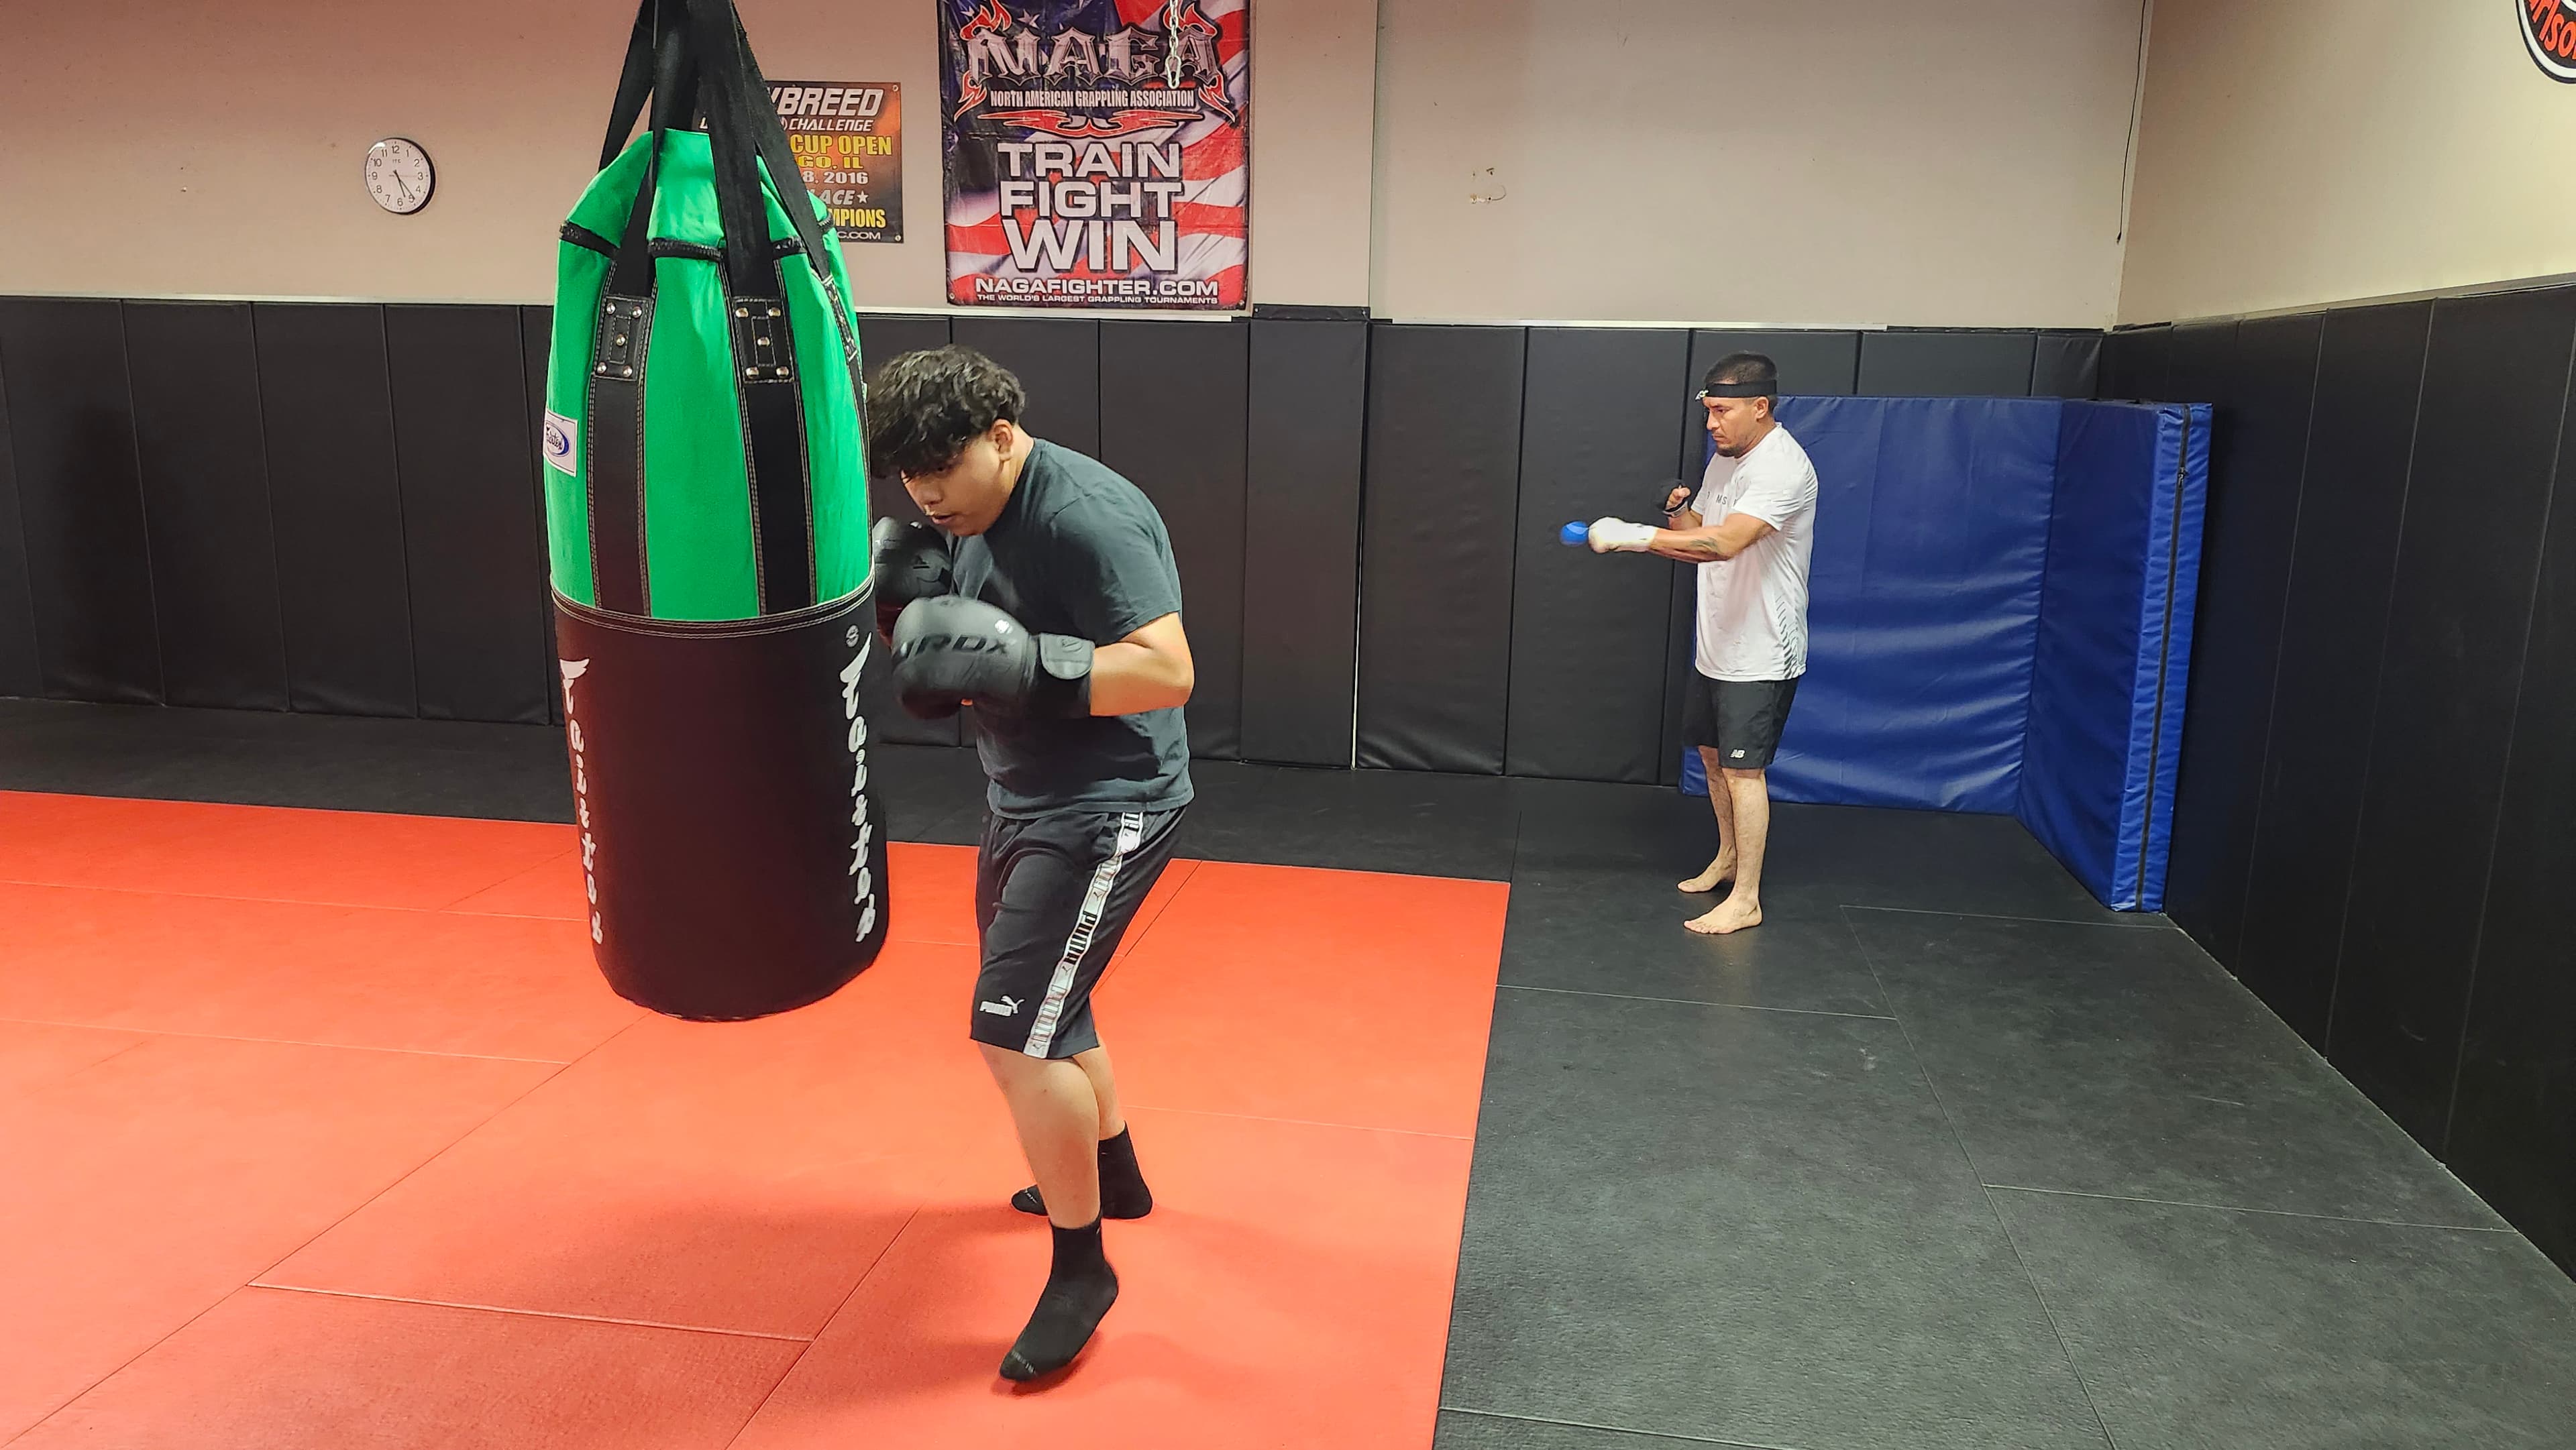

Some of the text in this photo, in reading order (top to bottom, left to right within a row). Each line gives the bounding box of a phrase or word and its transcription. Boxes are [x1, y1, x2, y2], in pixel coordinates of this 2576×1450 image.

[966, 27, 1220, 87] NAGA
[990, 90, 1195, 107] NORTH AMERICAN GRAPPLING ASSOCIATION
[789, 119, 873, 131] CHALLENGE
[392, 145, 400, 154] 12
[790, 135, 892, 155] CUP OPEN
[381, 149, 388, 158] 11
[373, 158, 382, 167] 10
[414, 158, 420, 168] 2
[797, 156, 864, 169] GO, IL
[998, 143, 1181, 178] TRAIN
[372, 171, 378, 180] 9
[417, 172, 424, 181] 3
[824, 172, 868, 184] 2016
[376, 184, 382, 194] 8
[416, 185, 421, 194] 4
[385, 194, 391, 203] 7
[818, 189, 856, 205] ACE
[1000, 182, 1182, 218] FIGHT
[397, 198, 404, 207] 6
[837, 231, 881, 240] C.COM
[1002, 220, 1175, 271] WIN
[975, 278, 1218, 296] NAGAFIGHTER.COM
[1144, 296, 1218, 304] TOURNAMENTS
